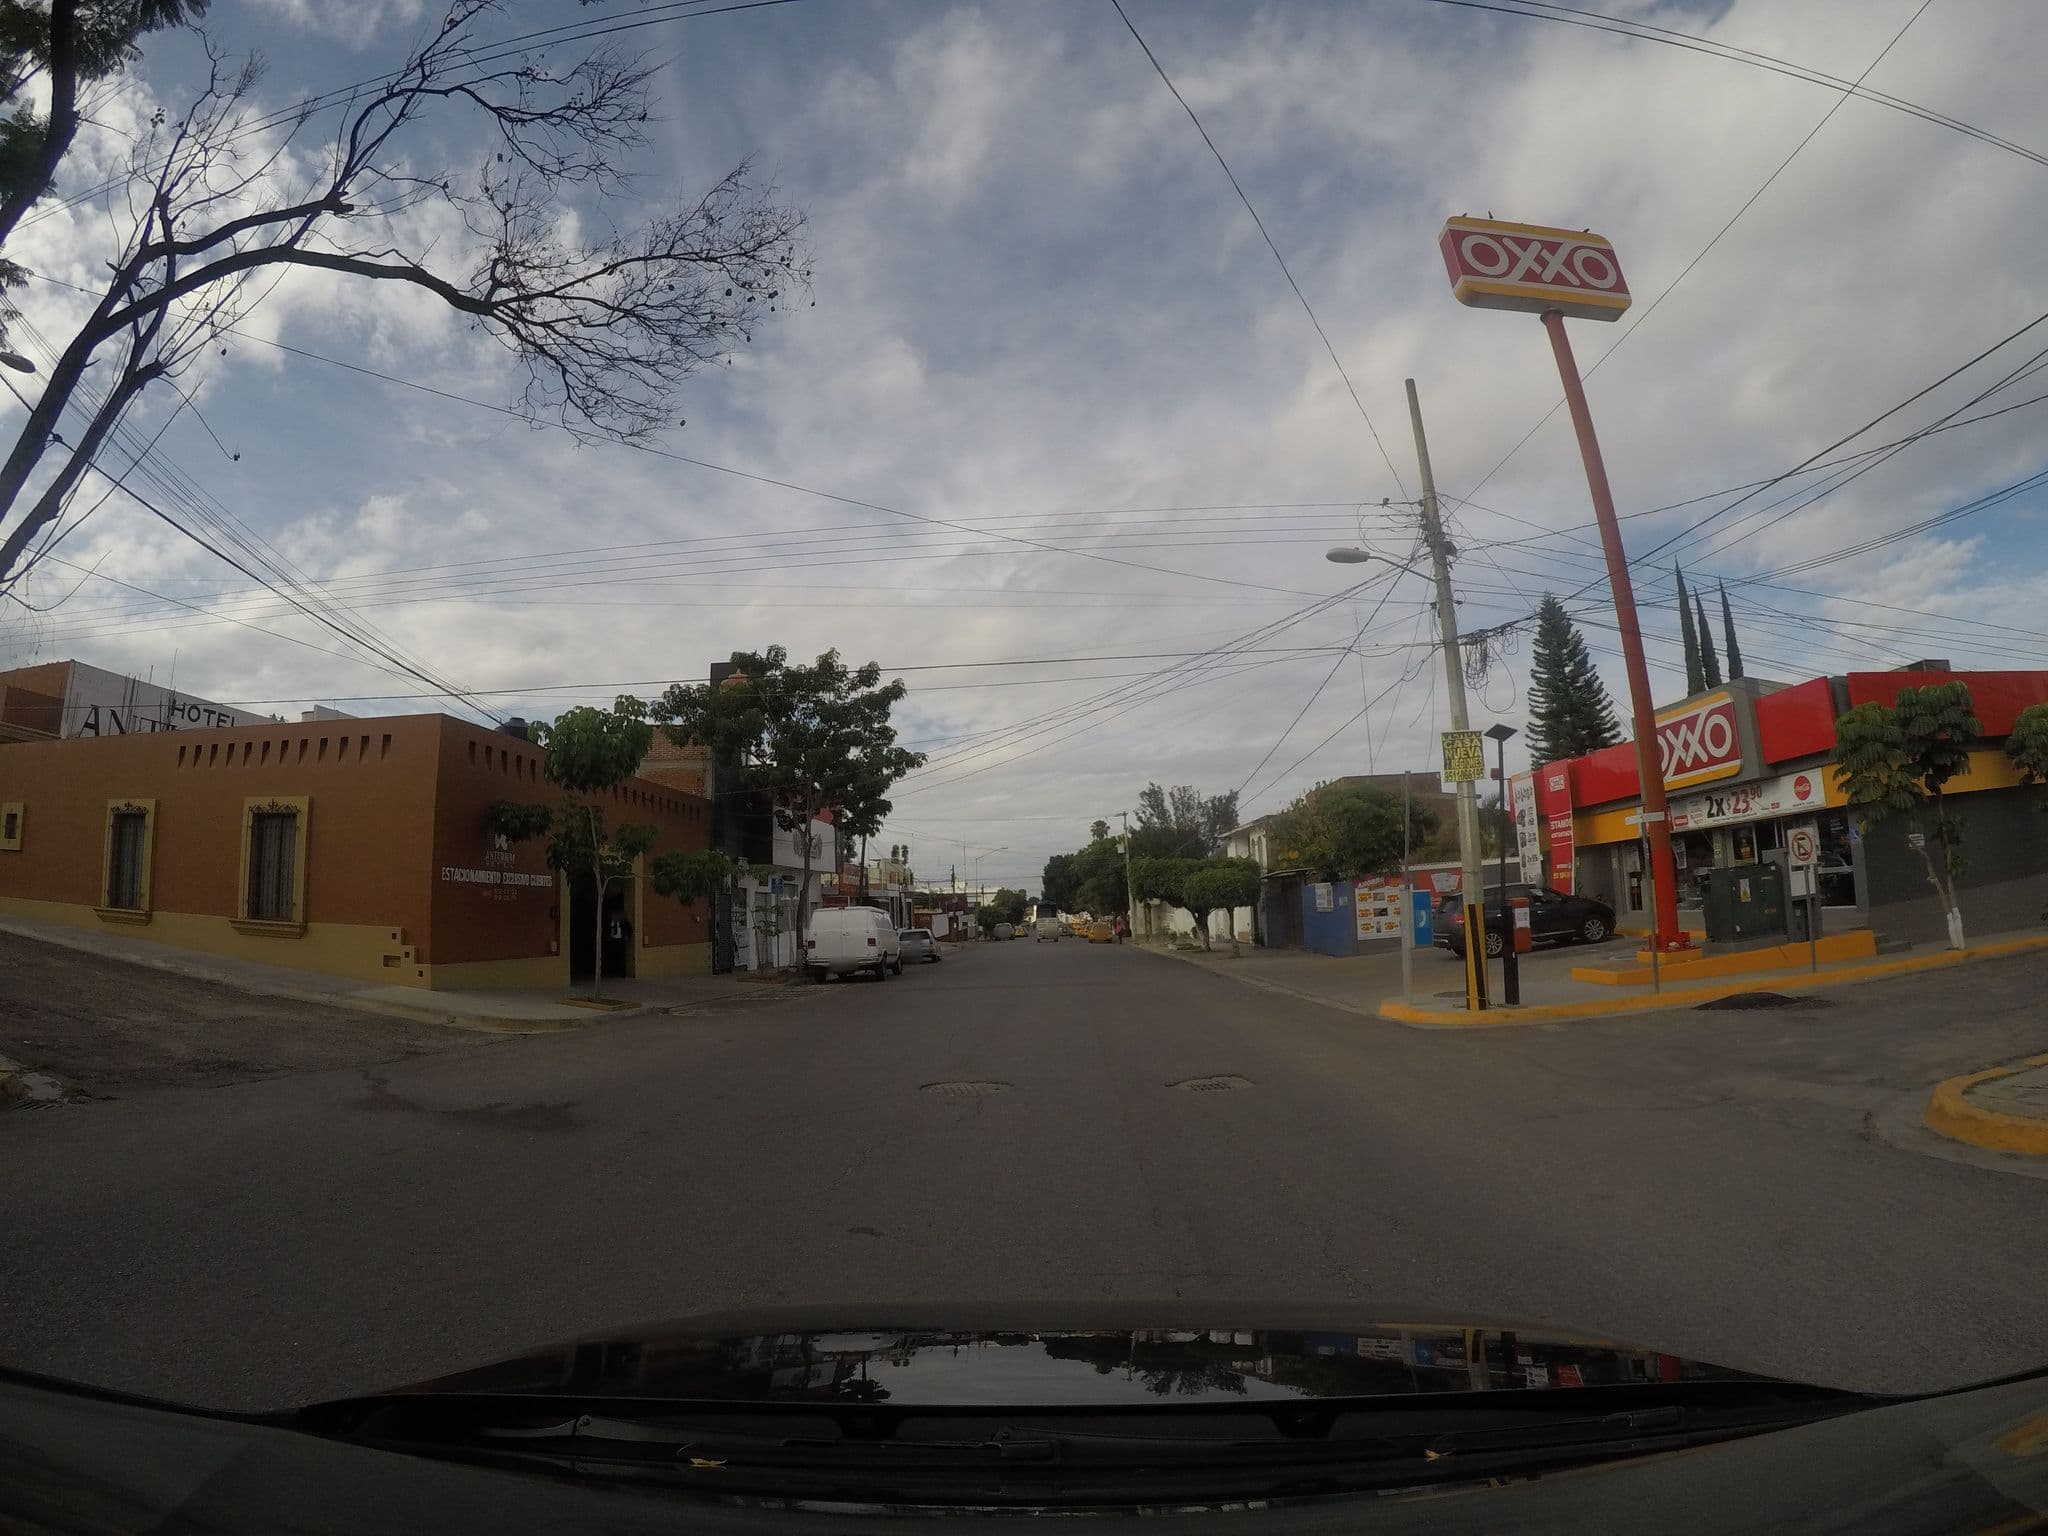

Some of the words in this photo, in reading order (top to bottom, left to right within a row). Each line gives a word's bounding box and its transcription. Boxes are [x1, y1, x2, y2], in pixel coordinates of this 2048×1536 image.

[1461, 234, 1617, 289] OXXO
[1443, 738, 1481, 749] CASA
[1444, 747, 1482, 760] NUEVA
[441, 867, 500, 884] ESTACIONAMIENTO
[530, 875, 553, 887] CLIENTES
